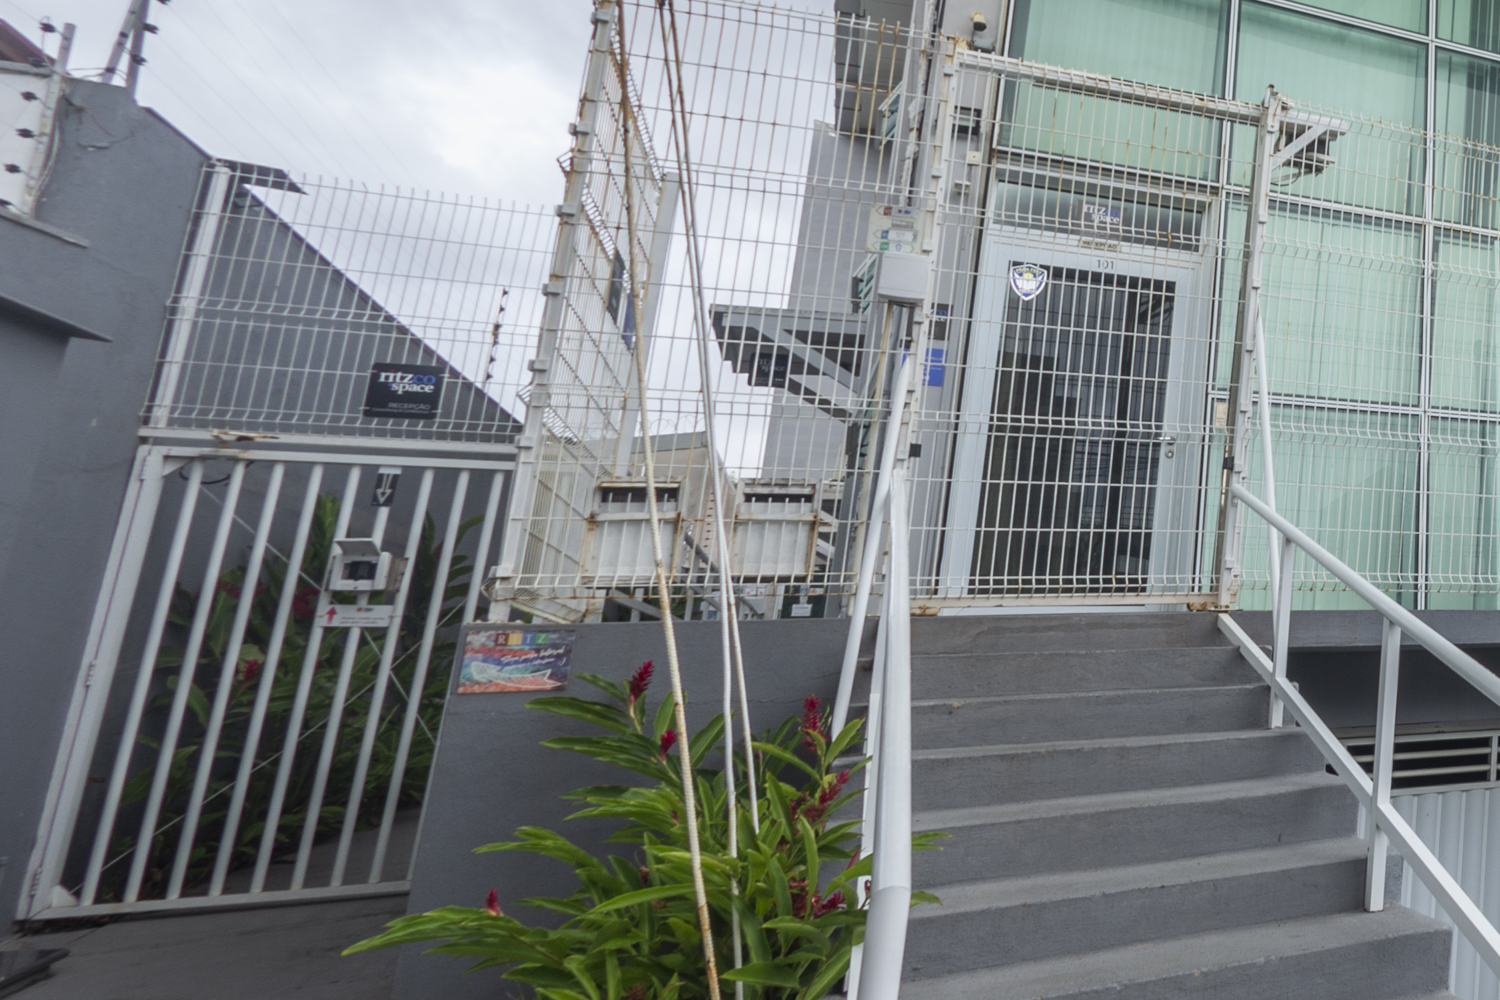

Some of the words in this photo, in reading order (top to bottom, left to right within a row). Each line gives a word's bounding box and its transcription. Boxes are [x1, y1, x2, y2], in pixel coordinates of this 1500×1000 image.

[1097, 259, 1114, 270] 101
[391, 383, 434, 394] space
[498, 634, 546, 644] RITZ
